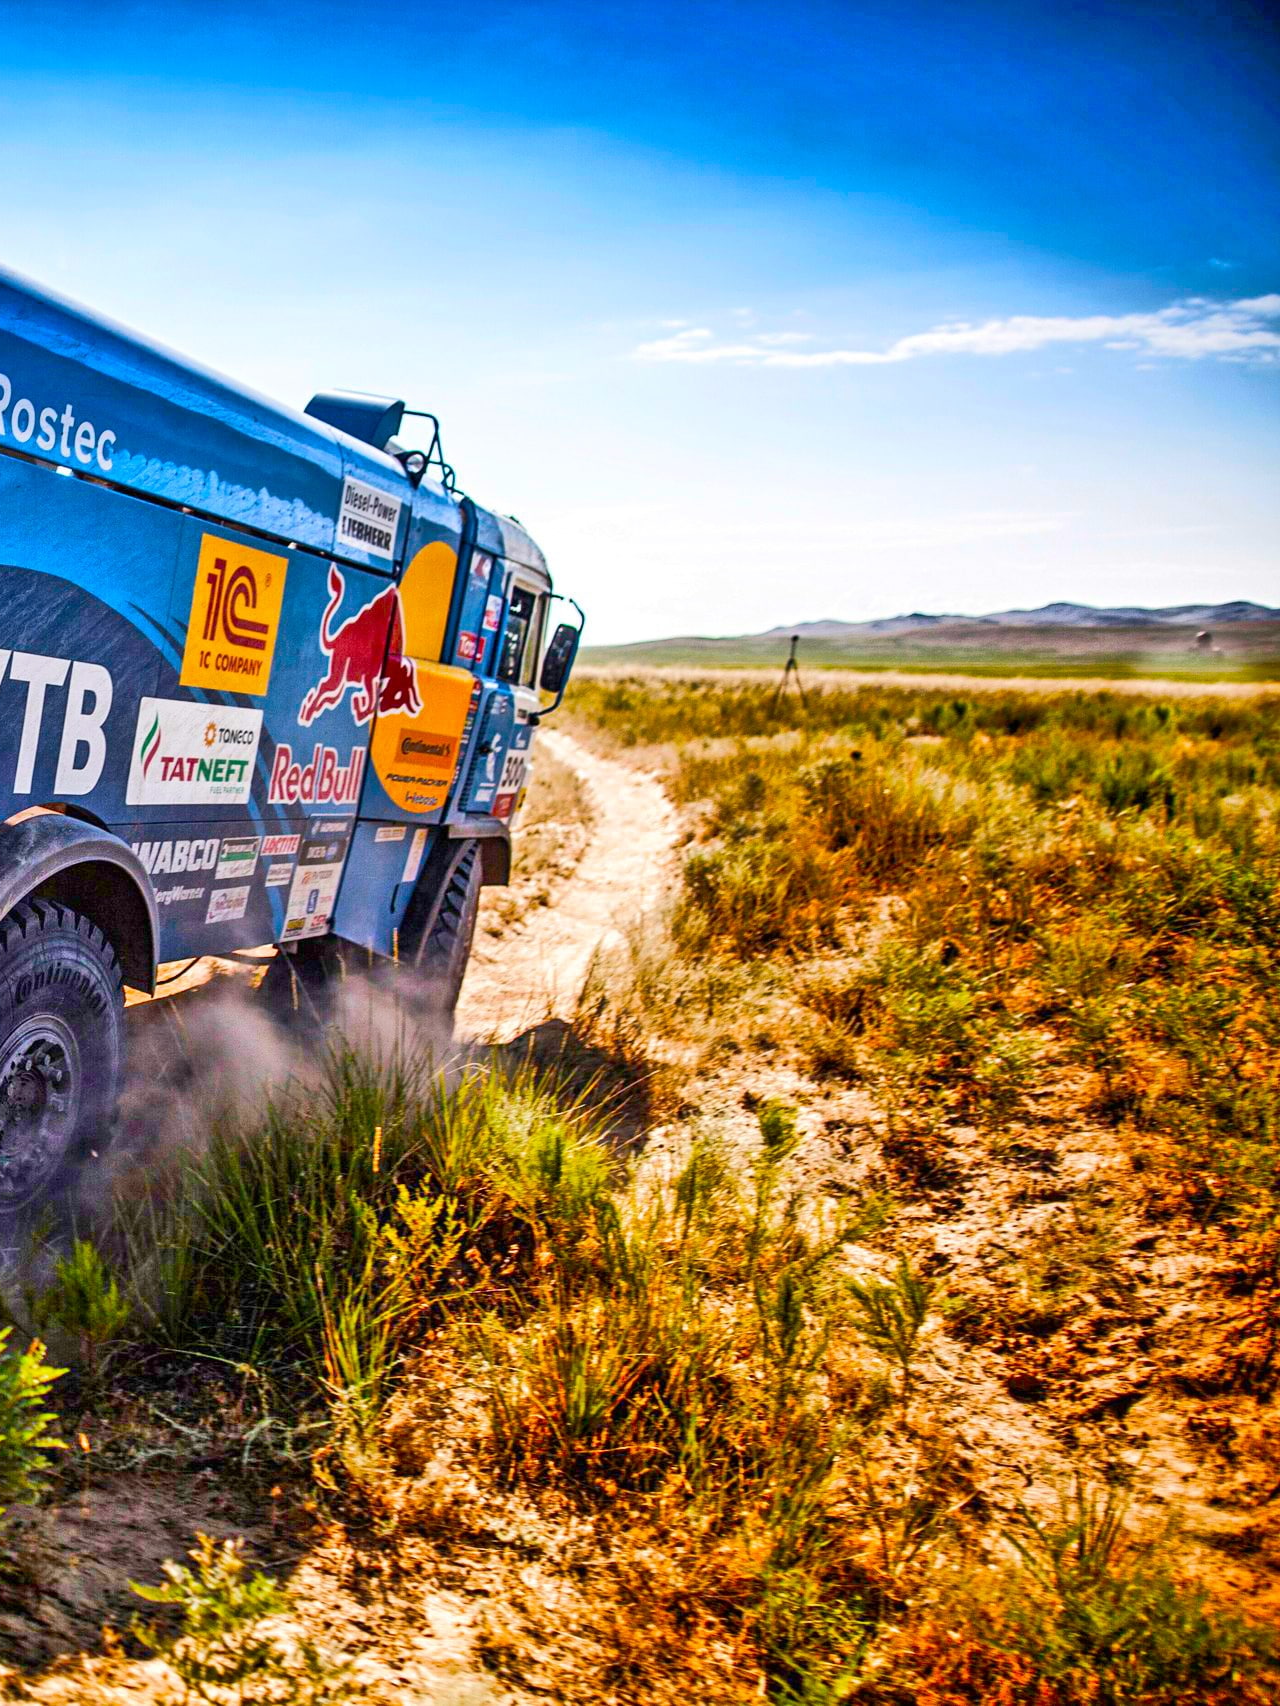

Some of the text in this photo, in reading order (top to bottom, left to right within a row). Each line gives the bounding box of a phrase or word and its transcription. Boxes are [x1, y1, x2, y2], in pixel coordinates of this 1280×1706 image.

[344, 484, 398, 523] Diesel-Power
[341, 515, 392, 551] LIEBHERR
[199, 650, 263, 677] 1C COMPANY
[160, 756, 249, 783] TATNEFT
[131, 838, 220, 875] WABCO
